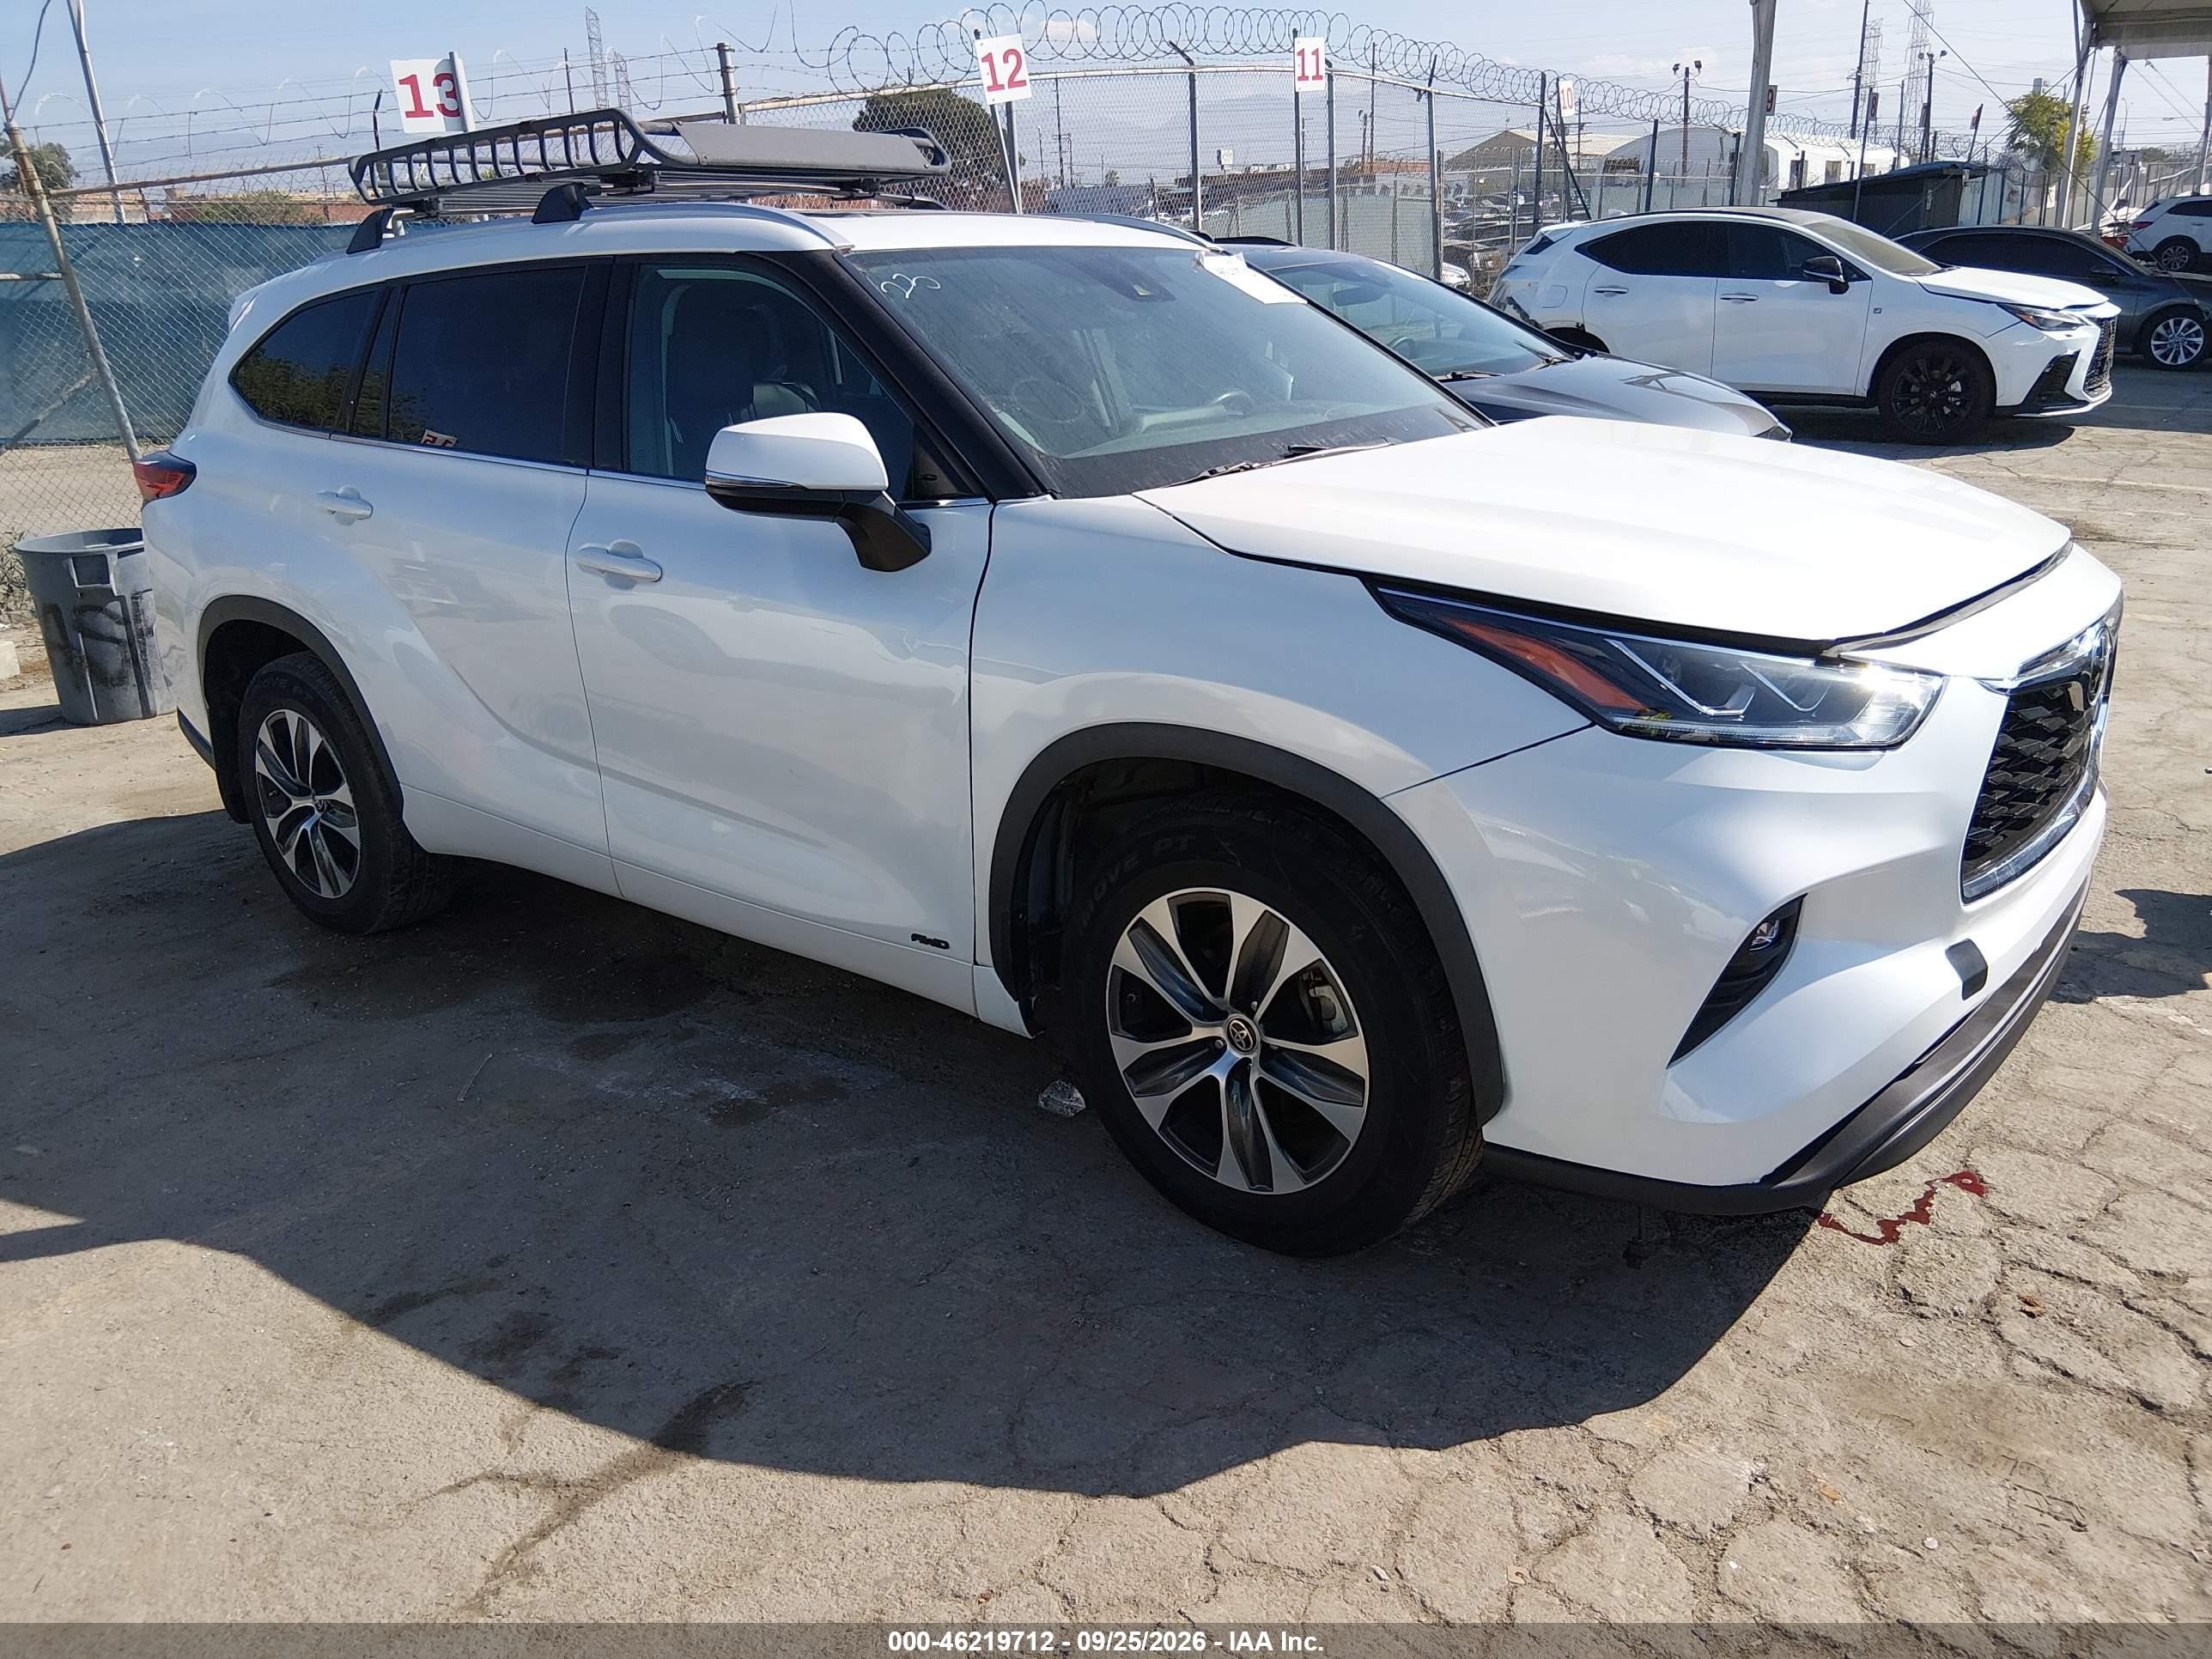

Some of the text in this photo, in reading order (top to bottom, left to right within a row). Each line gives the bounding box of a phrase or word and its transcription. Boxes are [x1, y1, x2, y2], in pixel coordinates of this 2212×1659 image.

[981, 48, 1027, 92] 12
[1297, 47, 1323, 82] 11
[398, 72, 460, 118] 13
[1560, 87, 1573, 110] 10
[1765, 88, 1774, 112] 9
[1870, 94, 1877, 118] 8
